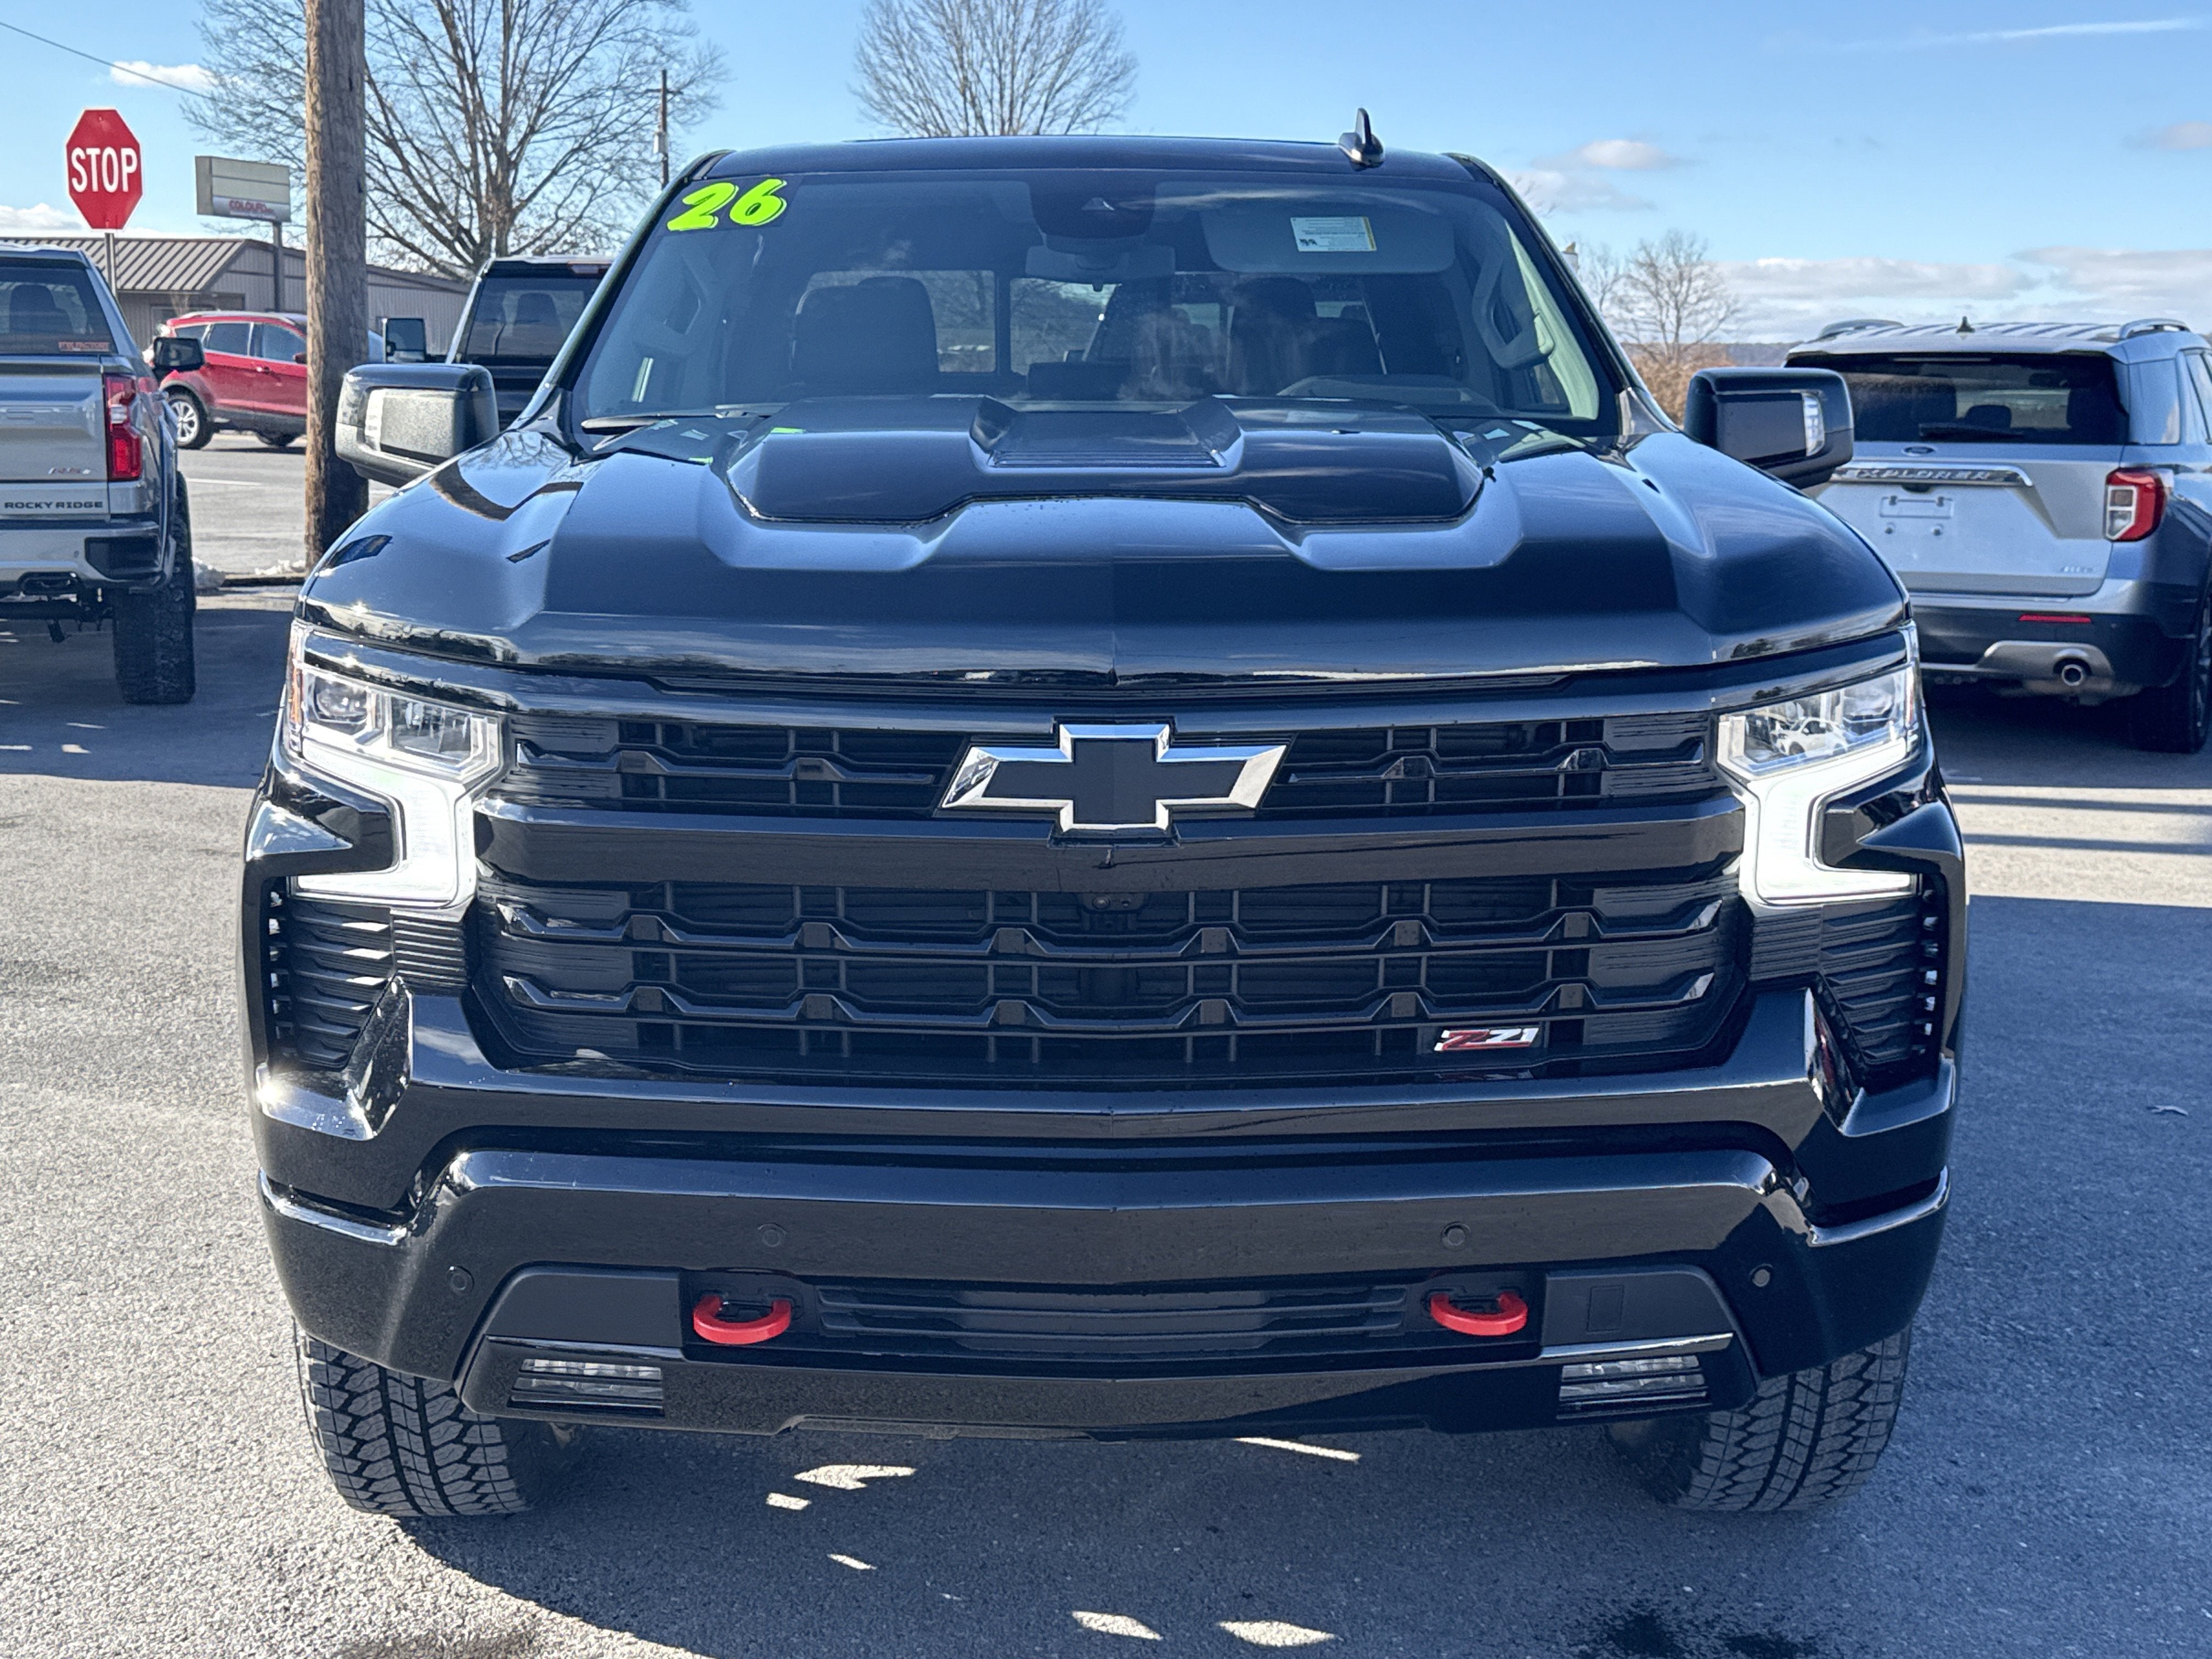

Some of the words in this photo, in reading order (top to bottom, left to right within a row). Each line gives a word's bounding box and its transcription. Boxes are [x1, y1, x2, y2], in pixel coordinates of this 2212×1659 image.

[71, 146, 138, 193] STOP
[667, 178, 788, 232] 26
[1434, 1027, 1539, 1052] Z71
